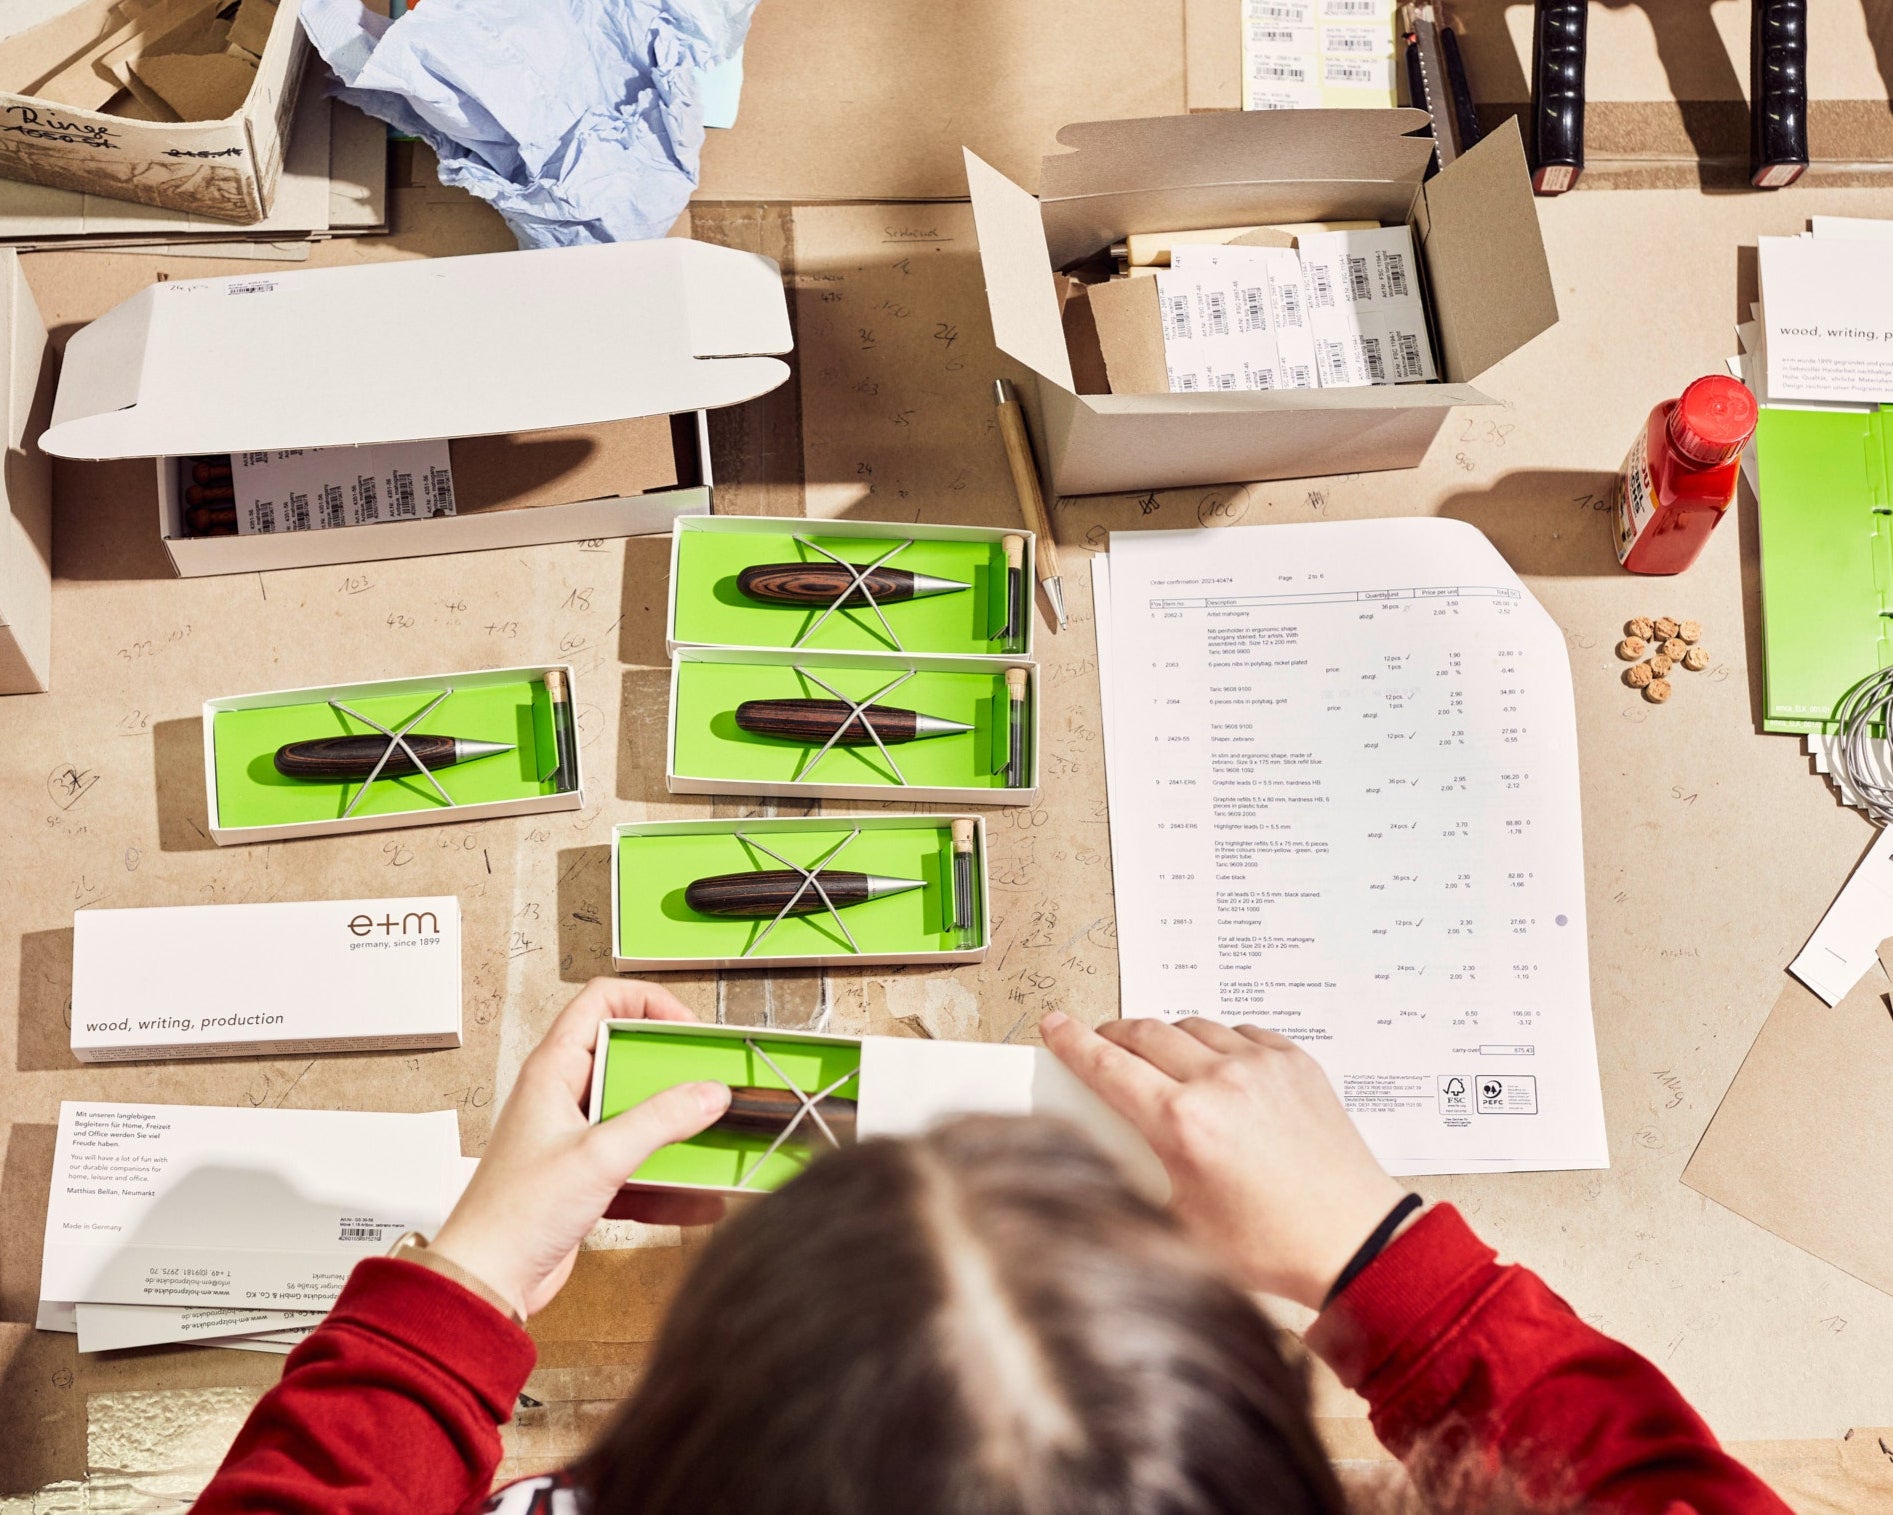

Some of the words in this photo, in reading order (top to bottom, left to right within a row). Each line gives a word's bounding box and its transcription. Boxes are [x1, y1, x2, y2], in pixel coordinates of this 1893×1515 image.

[934, 324, 959, 348] 24
[1780, 327, 1821, 337] wood,
[1828, 328, 1878, 340] writing,
[856, 462, 872, 474] 24
[561, 587, 594, 610] 18
[386, 612, 415, 628] 430
[484, 623, 518, 638] +13
[559, 633, 586, 651] 60
[514, 903, 540, 920] 13
[347, 912, 440, 937] e+m
[349, 940, 391, 951] germany,
[393, 939, 416, 948] since
[419, 937, 440, 946] 1899
[511, 932, 532, 951] 24
[86, 1017, 132, 1032] wood,
[138, 1015, 195, 1031] writing,
[200, 1012, 284, 1029] production
[117, 1112, 155, 1120] langlebigen
[98, 1188, 120, 1196] Bellan,
[145, 1277, 230, 1286] info@em-holzprodukte.de
[144, 1287, 229, 1296] www.em-holzprodukte.de
[181, 1315, 267, 1331] www.em-holzprodukte.de
